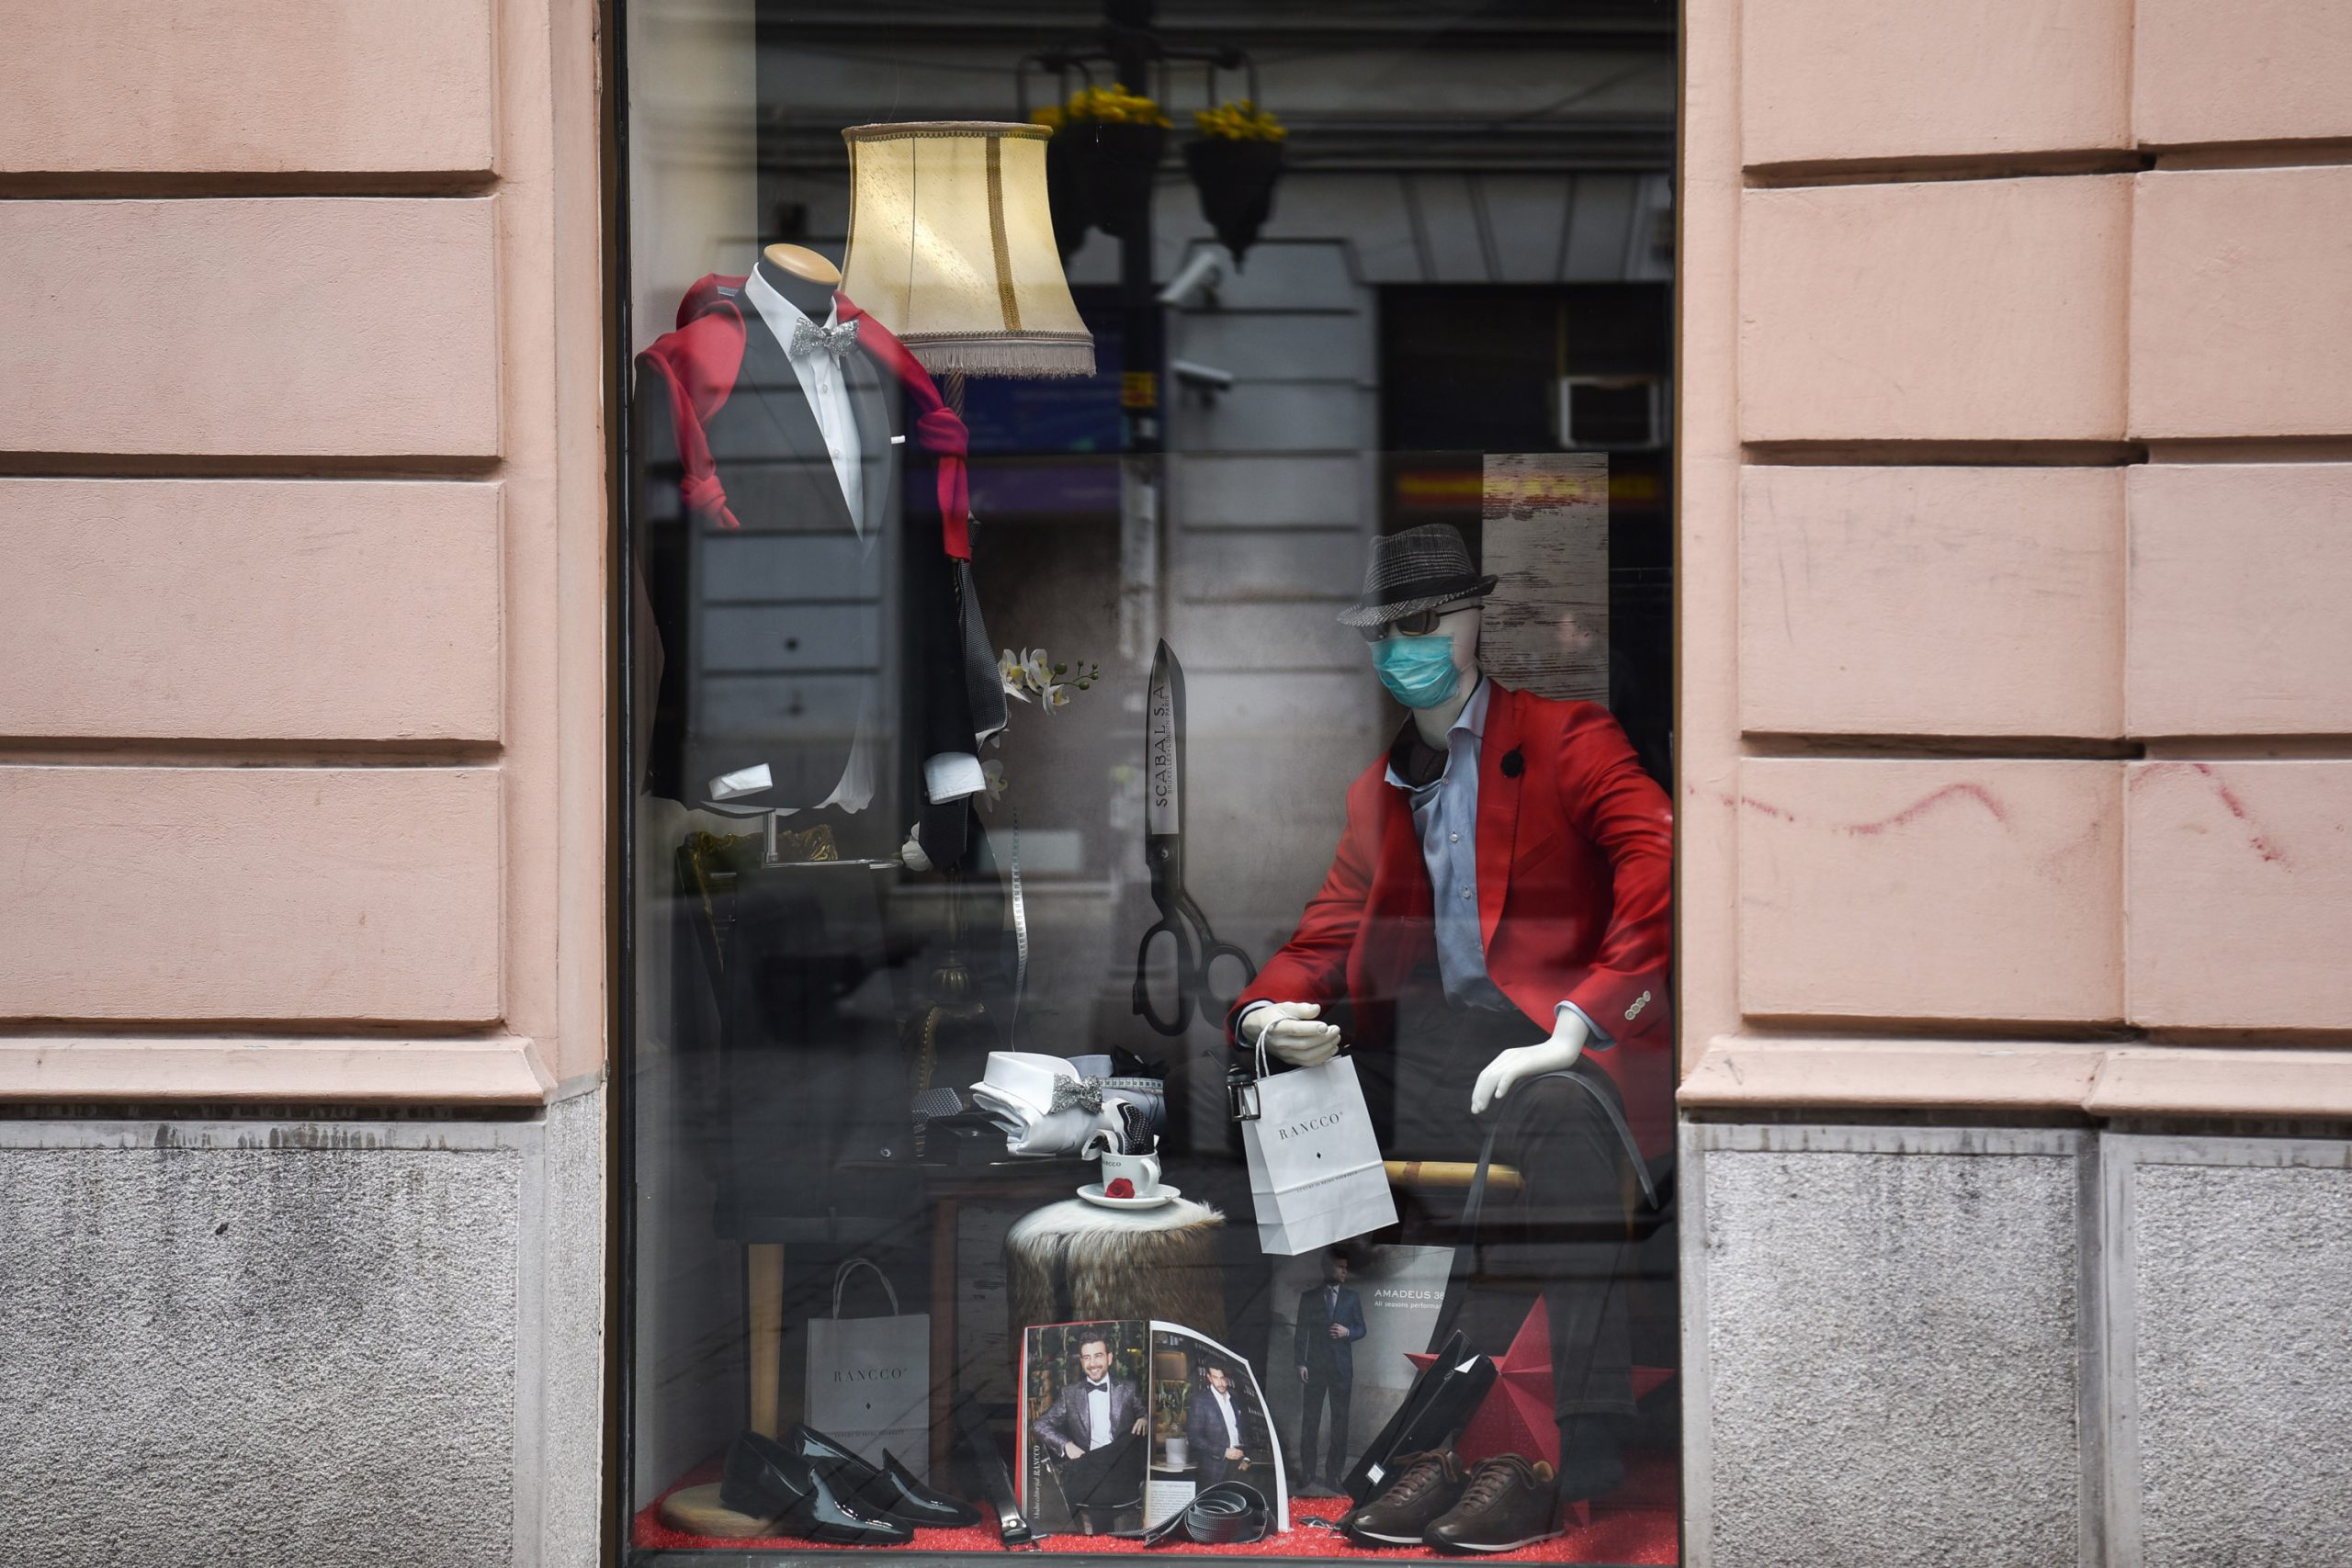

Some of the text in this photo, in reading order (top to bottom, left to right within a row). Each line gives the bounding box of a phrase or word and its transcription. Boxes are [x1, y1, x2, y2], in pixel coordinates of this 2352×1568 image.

[1154, 724, 1168, 808] SCABAL
[1278, 1112, 1340, 1140] RANCCO
[1374, 1289, 1431, 1300] AMADEUS
[834, 1368, 901, 1382] RANCCO
[1033, 1445, 1041, 1476] RANCCO
